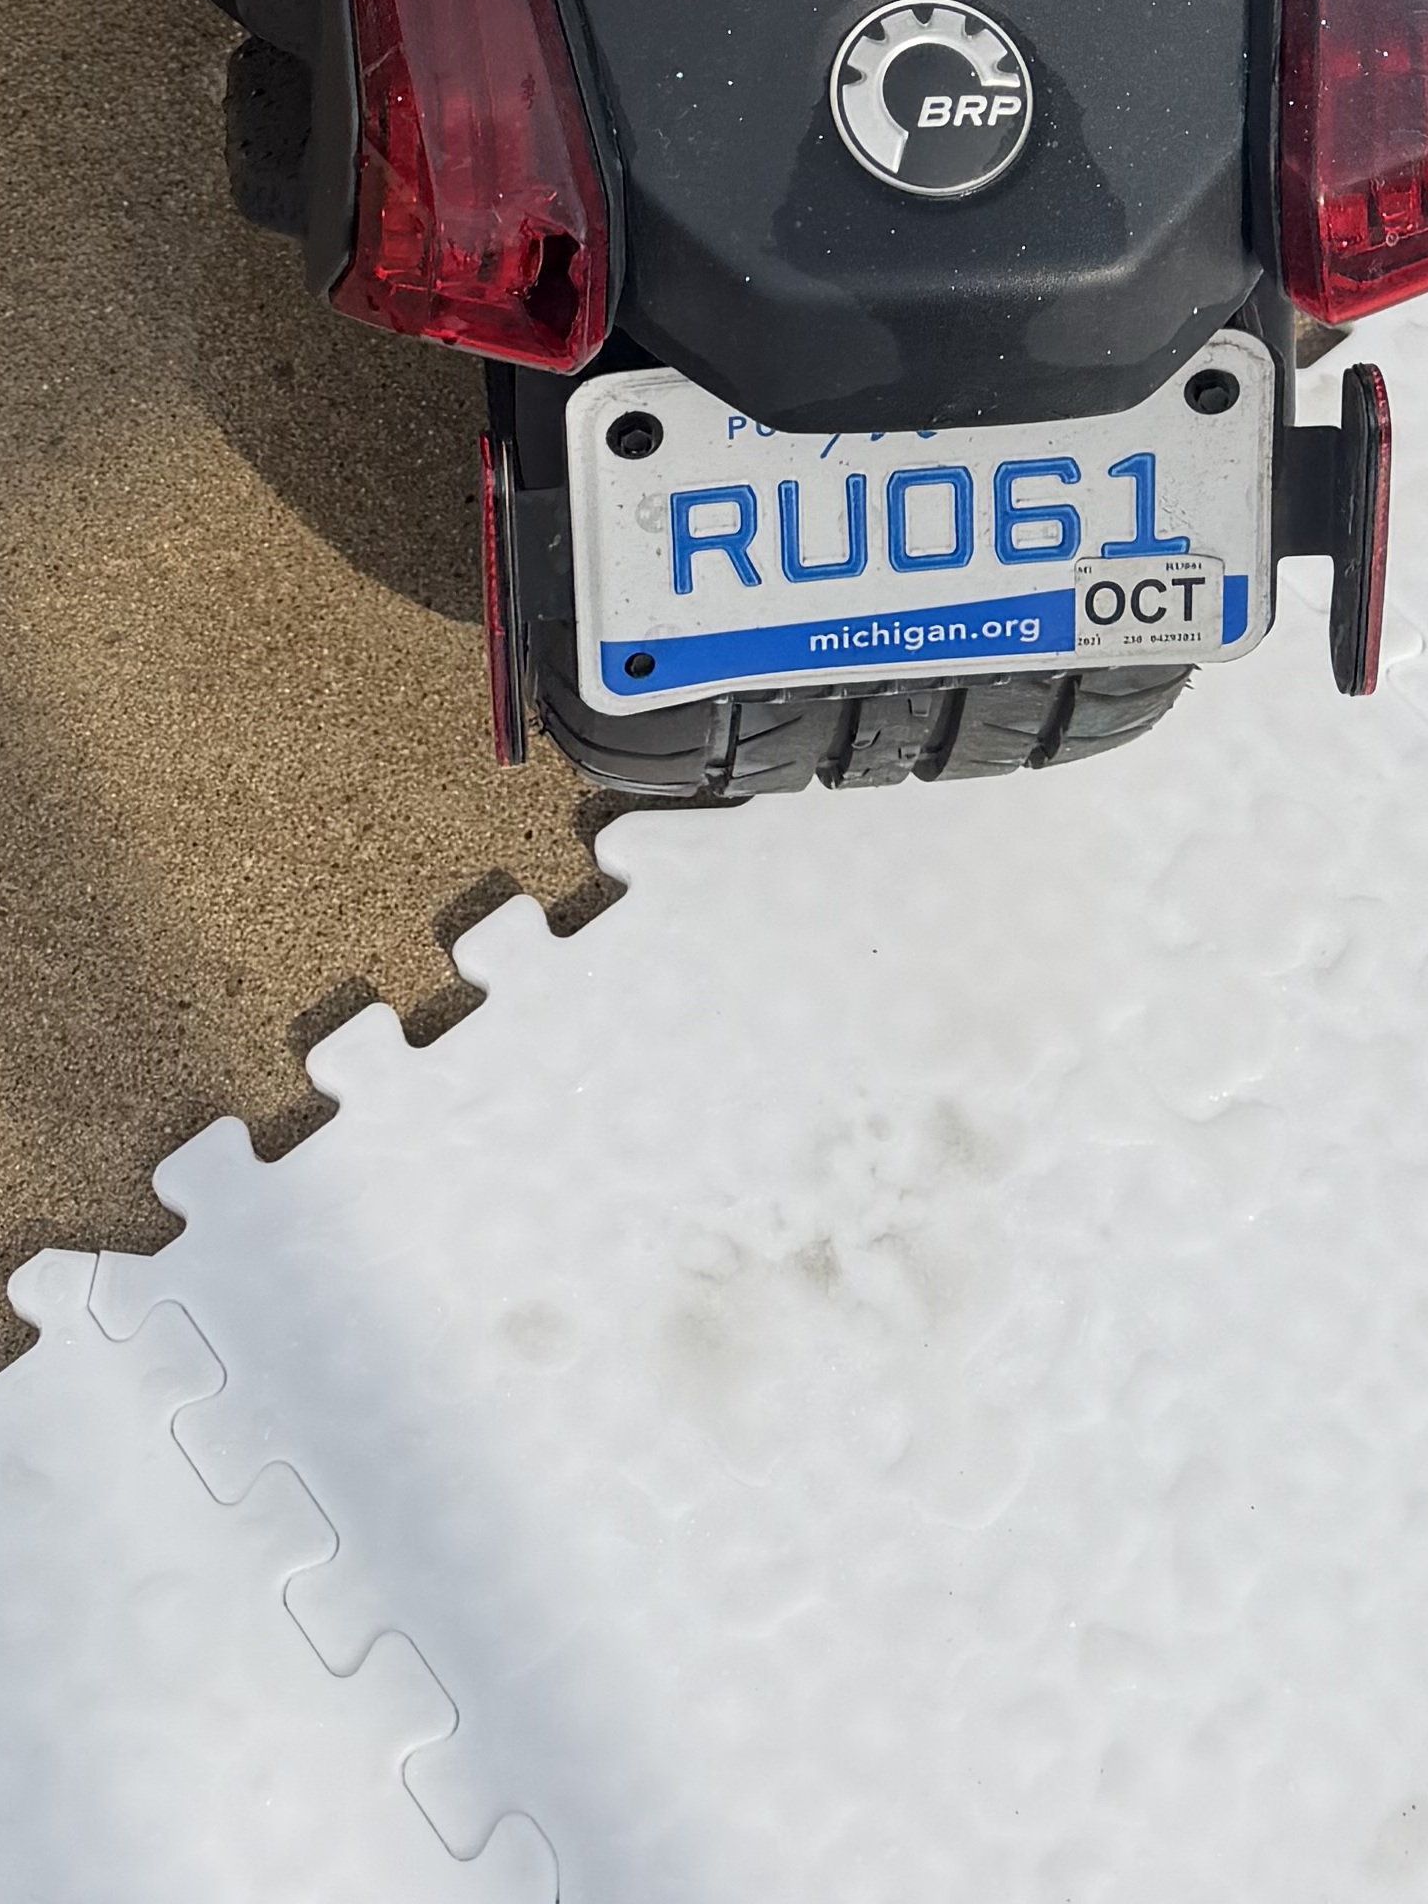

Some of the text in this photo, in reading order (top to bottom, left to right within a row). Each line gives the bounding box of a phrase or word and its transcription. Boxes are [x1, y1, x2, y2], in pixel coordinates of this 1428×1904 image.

[917, 94, 1022, 128] BRP
[1084, 576, 1206, 626] OCT
[808, 613, 1041, 653] michigan.org
